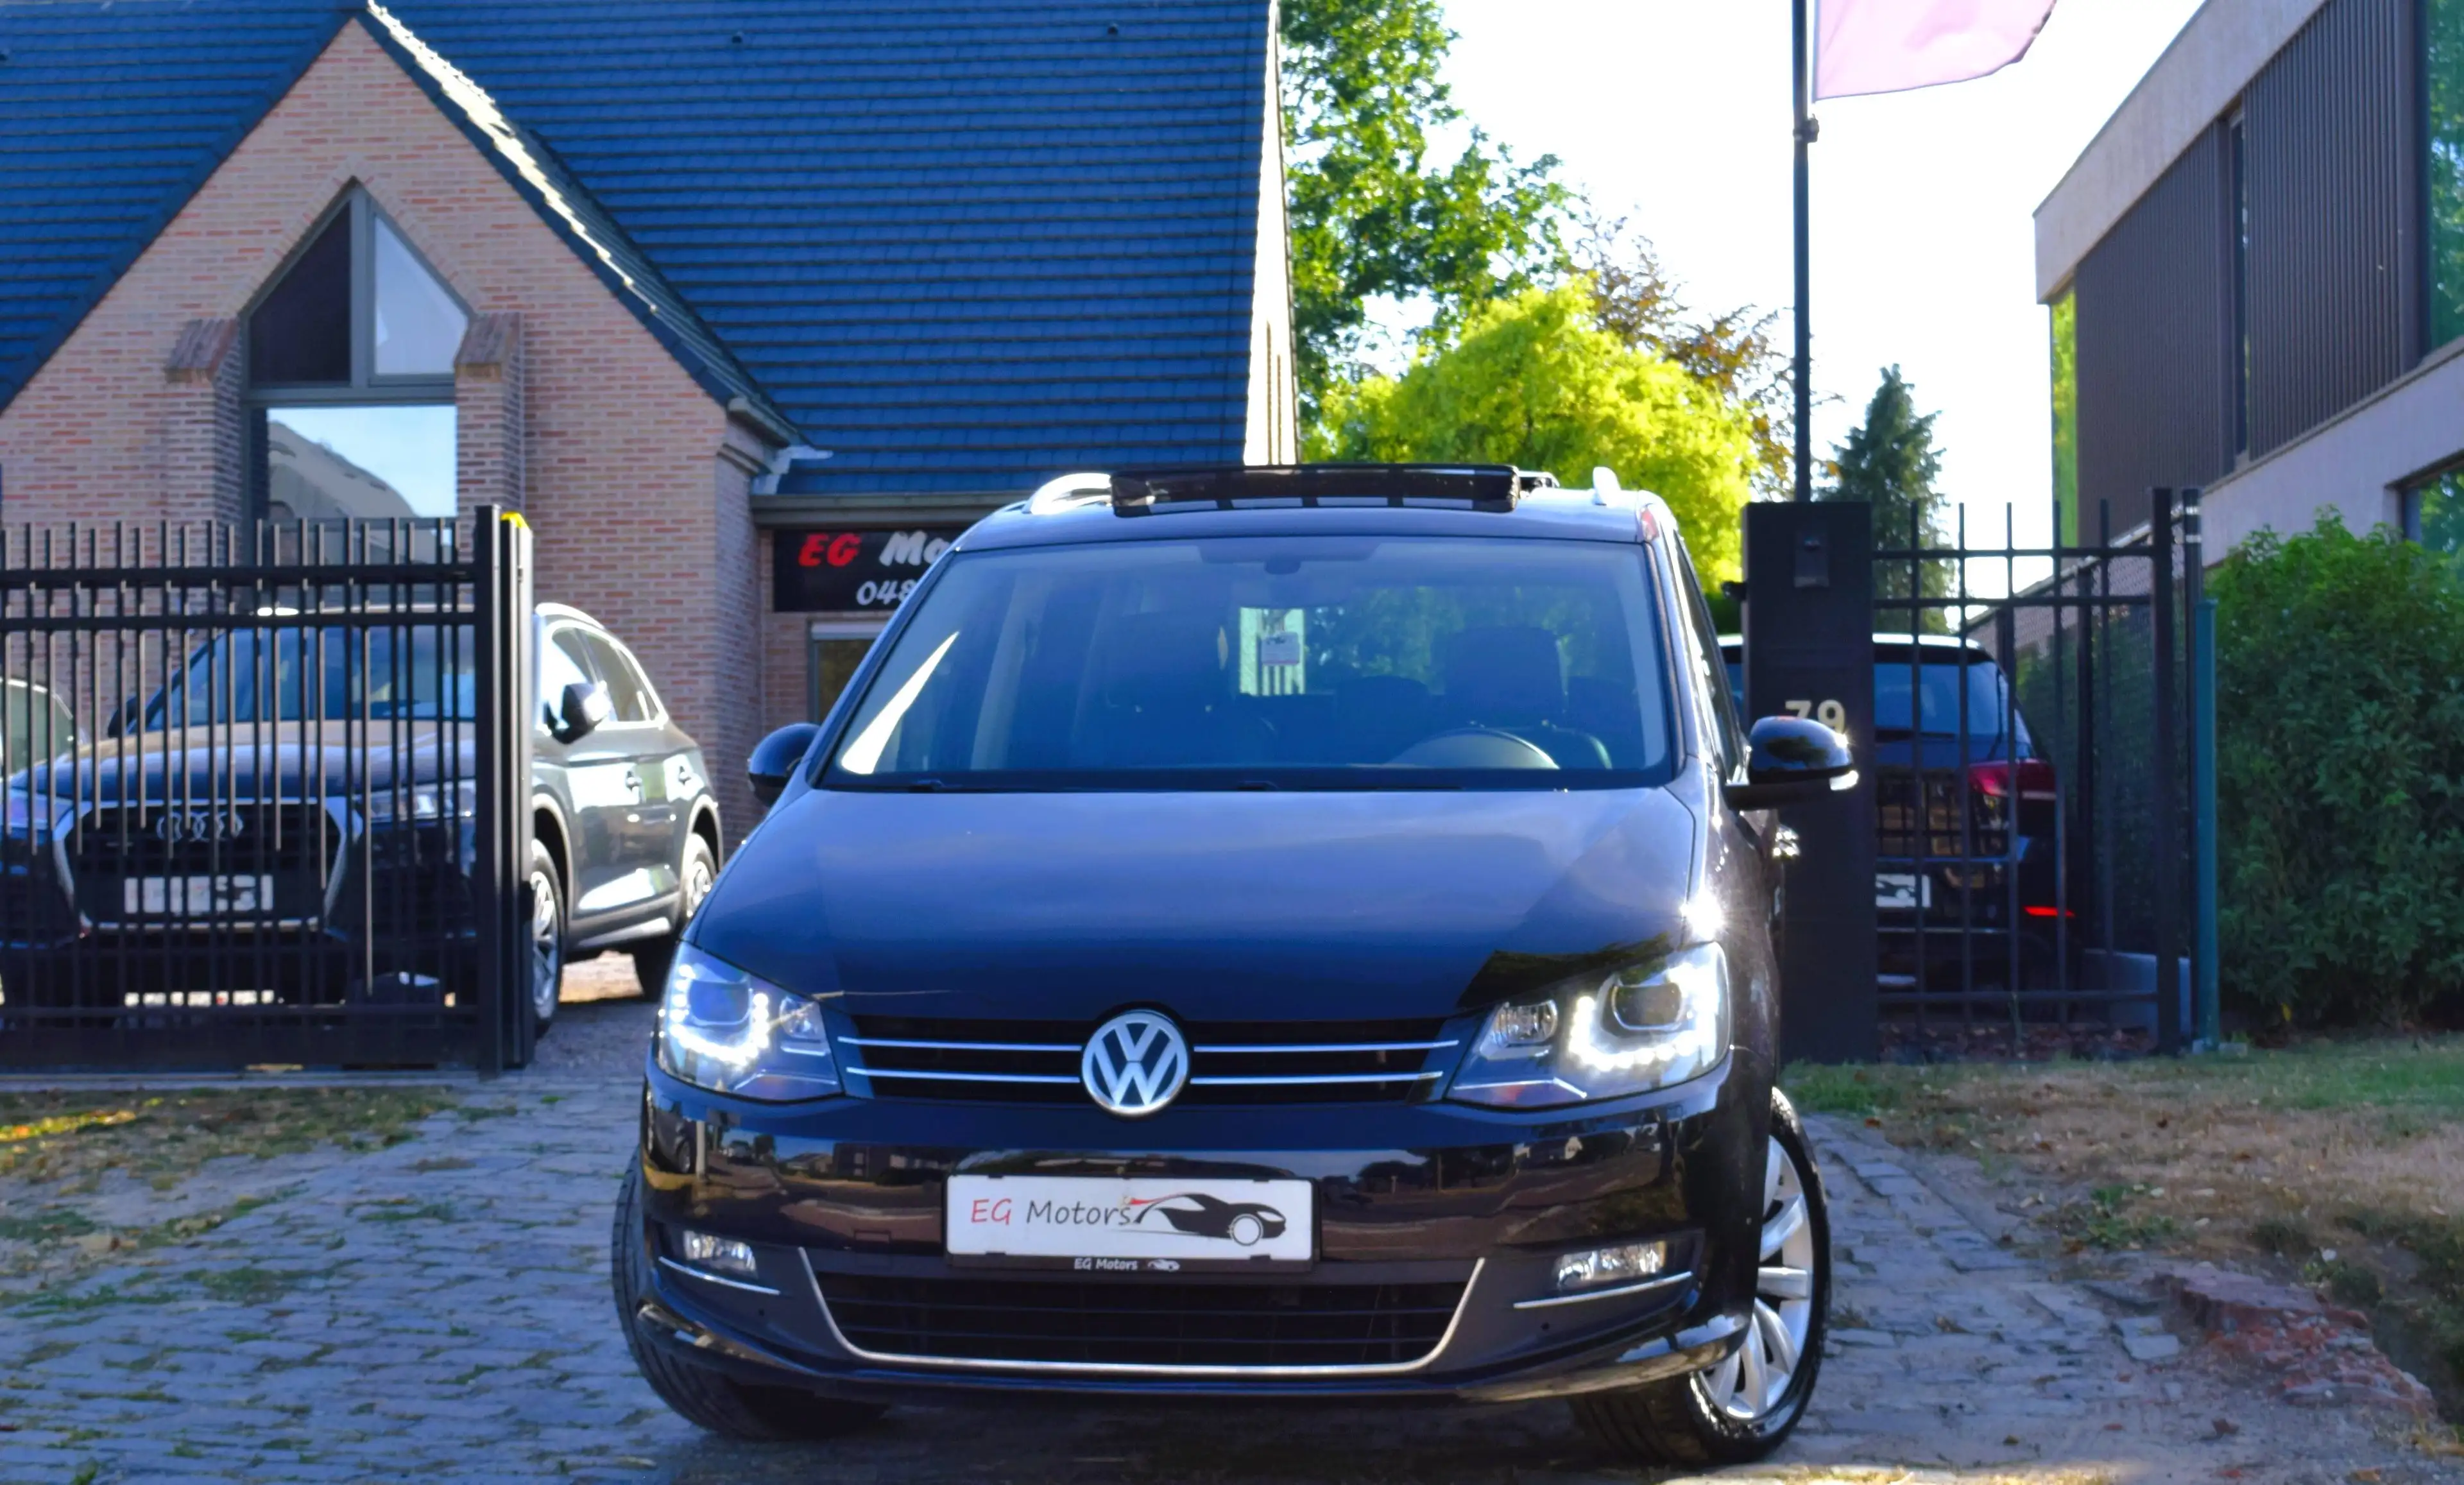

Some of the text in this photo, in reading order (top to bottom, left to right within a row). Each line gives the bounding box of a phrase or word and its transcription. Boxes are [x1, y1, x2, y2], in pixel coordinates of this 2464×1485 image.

[798, 533, 861, 567] EG
[971, 1198, 1132, 1226] EG Motors
[1074, 1257, 1138, 1271] EG Motors
